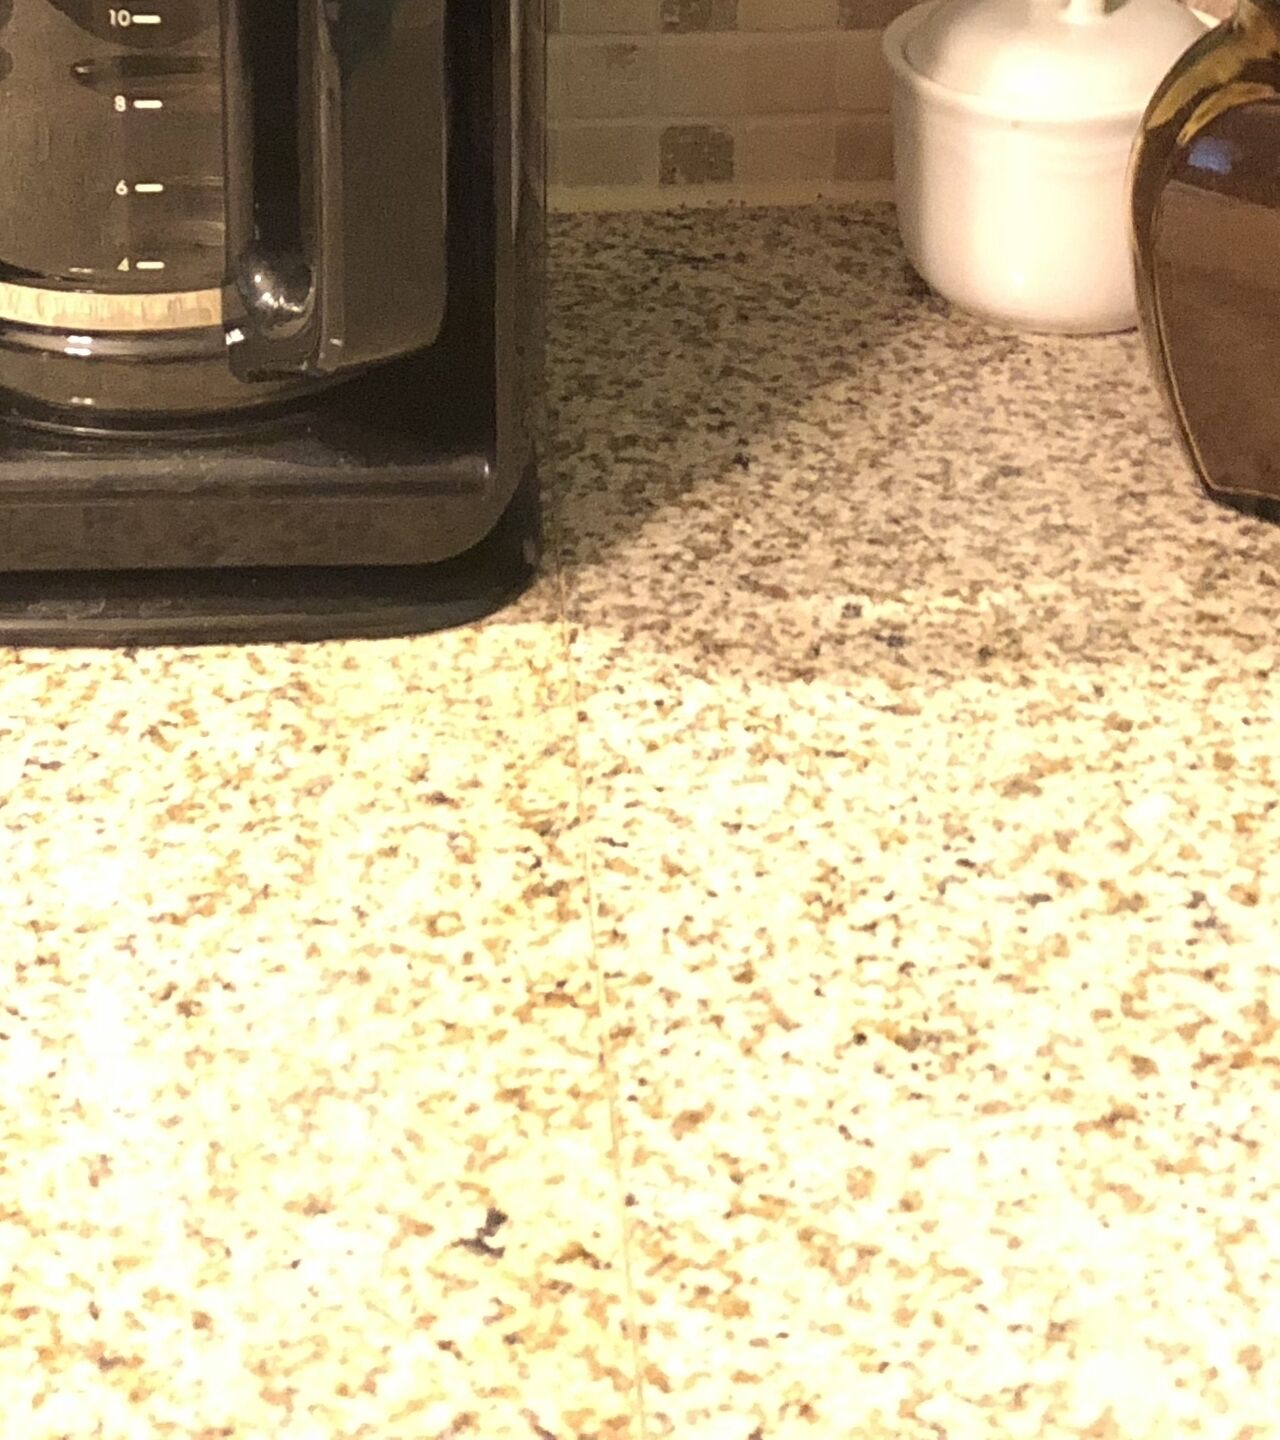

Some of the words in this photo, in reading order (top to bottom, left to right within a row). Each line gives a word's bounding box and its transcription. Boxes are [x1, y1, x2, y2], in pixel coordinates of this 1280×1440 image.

[108, 9, 132, 27] 10
[113, 95, 127, 112] 8
[115, 179, 129, 196] 6
